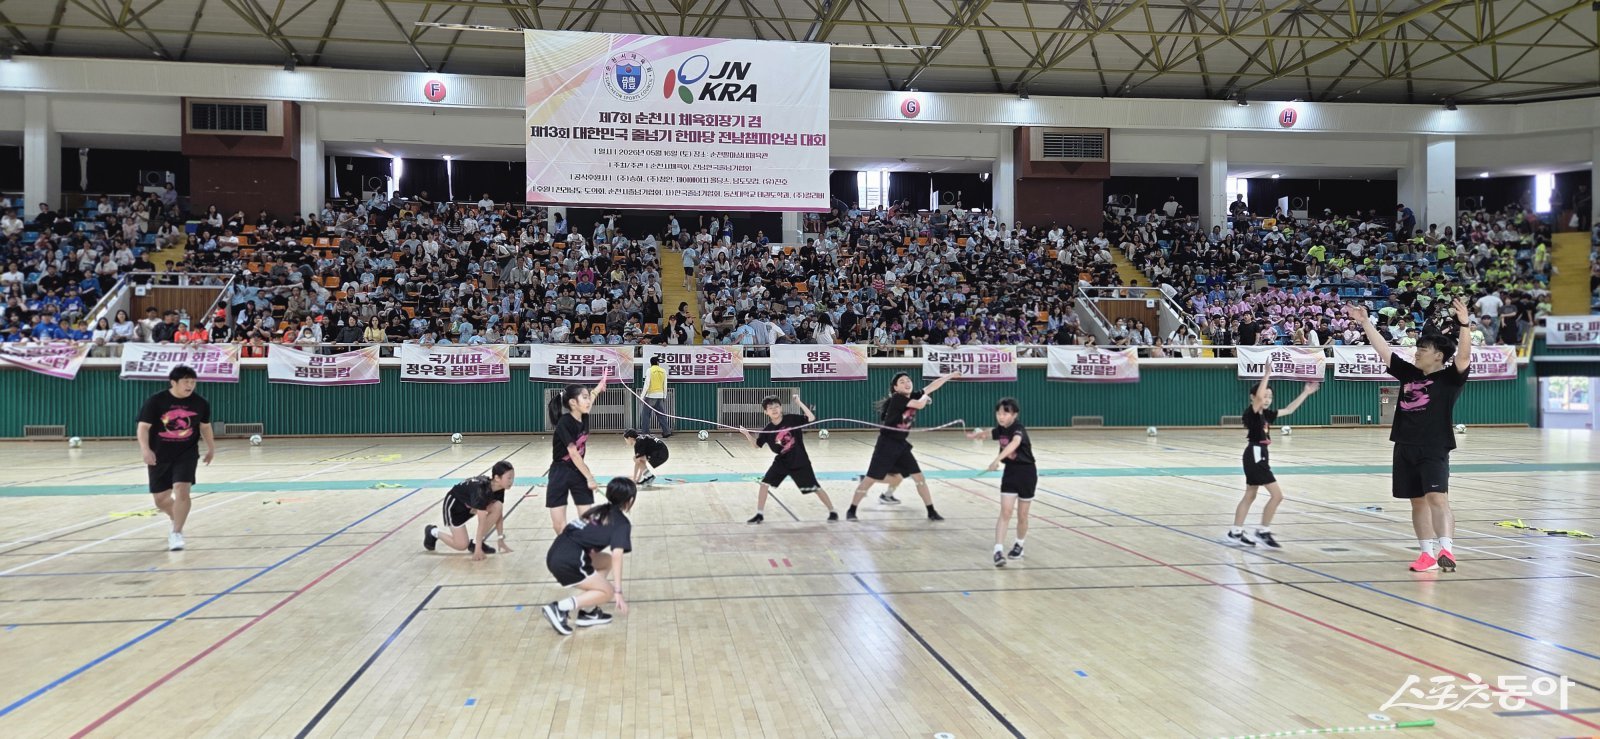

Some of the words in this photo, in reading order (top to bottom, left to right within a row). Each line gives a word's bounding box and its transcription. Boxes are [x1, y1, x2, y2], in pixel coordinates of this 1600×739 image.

[708, 61, 751, 81] JN
[431, 83, 440, 97] F
[698, 82, 758, 103] KRA
[906, 100, 916, 113] G
[599, 111, 632, 124] 제7회
[635, 112, 676, 126] 순천시
[678, 113, 746, 128] 체육회장기
[748, 115, 762, 129] 겸
[1284, 110, 1293, 123] H
[530, 125, 570, 139] 제13회
[573, 126, 629, 141] 대한민국
[631, 128, 672, 142] 줄넘기
[675, 129, 716, 144] 한마당
[718, 131, 798, 146] 전남챔피언십
[800, 133, 826, 147] 대회
[646, 149, 662, 157] 05월
[679, 150, 692, 158] (토)
[141, 350, 188, 362] 경희대
[428, 353, 483, 365] 국가대표
[653, 352, 692, 364] 경희대
[695, 352, 732, 364] 양호찬
[806, 351, 831, 362] 영웅
[927, 351, 974, 363] 성균관대
[977, 351, 1012, 363] 지킴이
[294, 366, 351, 379] 점핑클럽
[406, 363, 447, 376] 정우용
[450, 363, 504, 376] 점핑클럽
[547, 364, 587, 377] 줄넘기
[590, 365, 616, 377] 클럽
[668, 364, 719, 376] 점핑클럽
[800, 362, 837, 374] 태권도
[939, 363, 974, 375] 줄넘기
[978, 363, 1001, 375] 클럽
[1070, 364, 1117, 376] 점핑클럽
